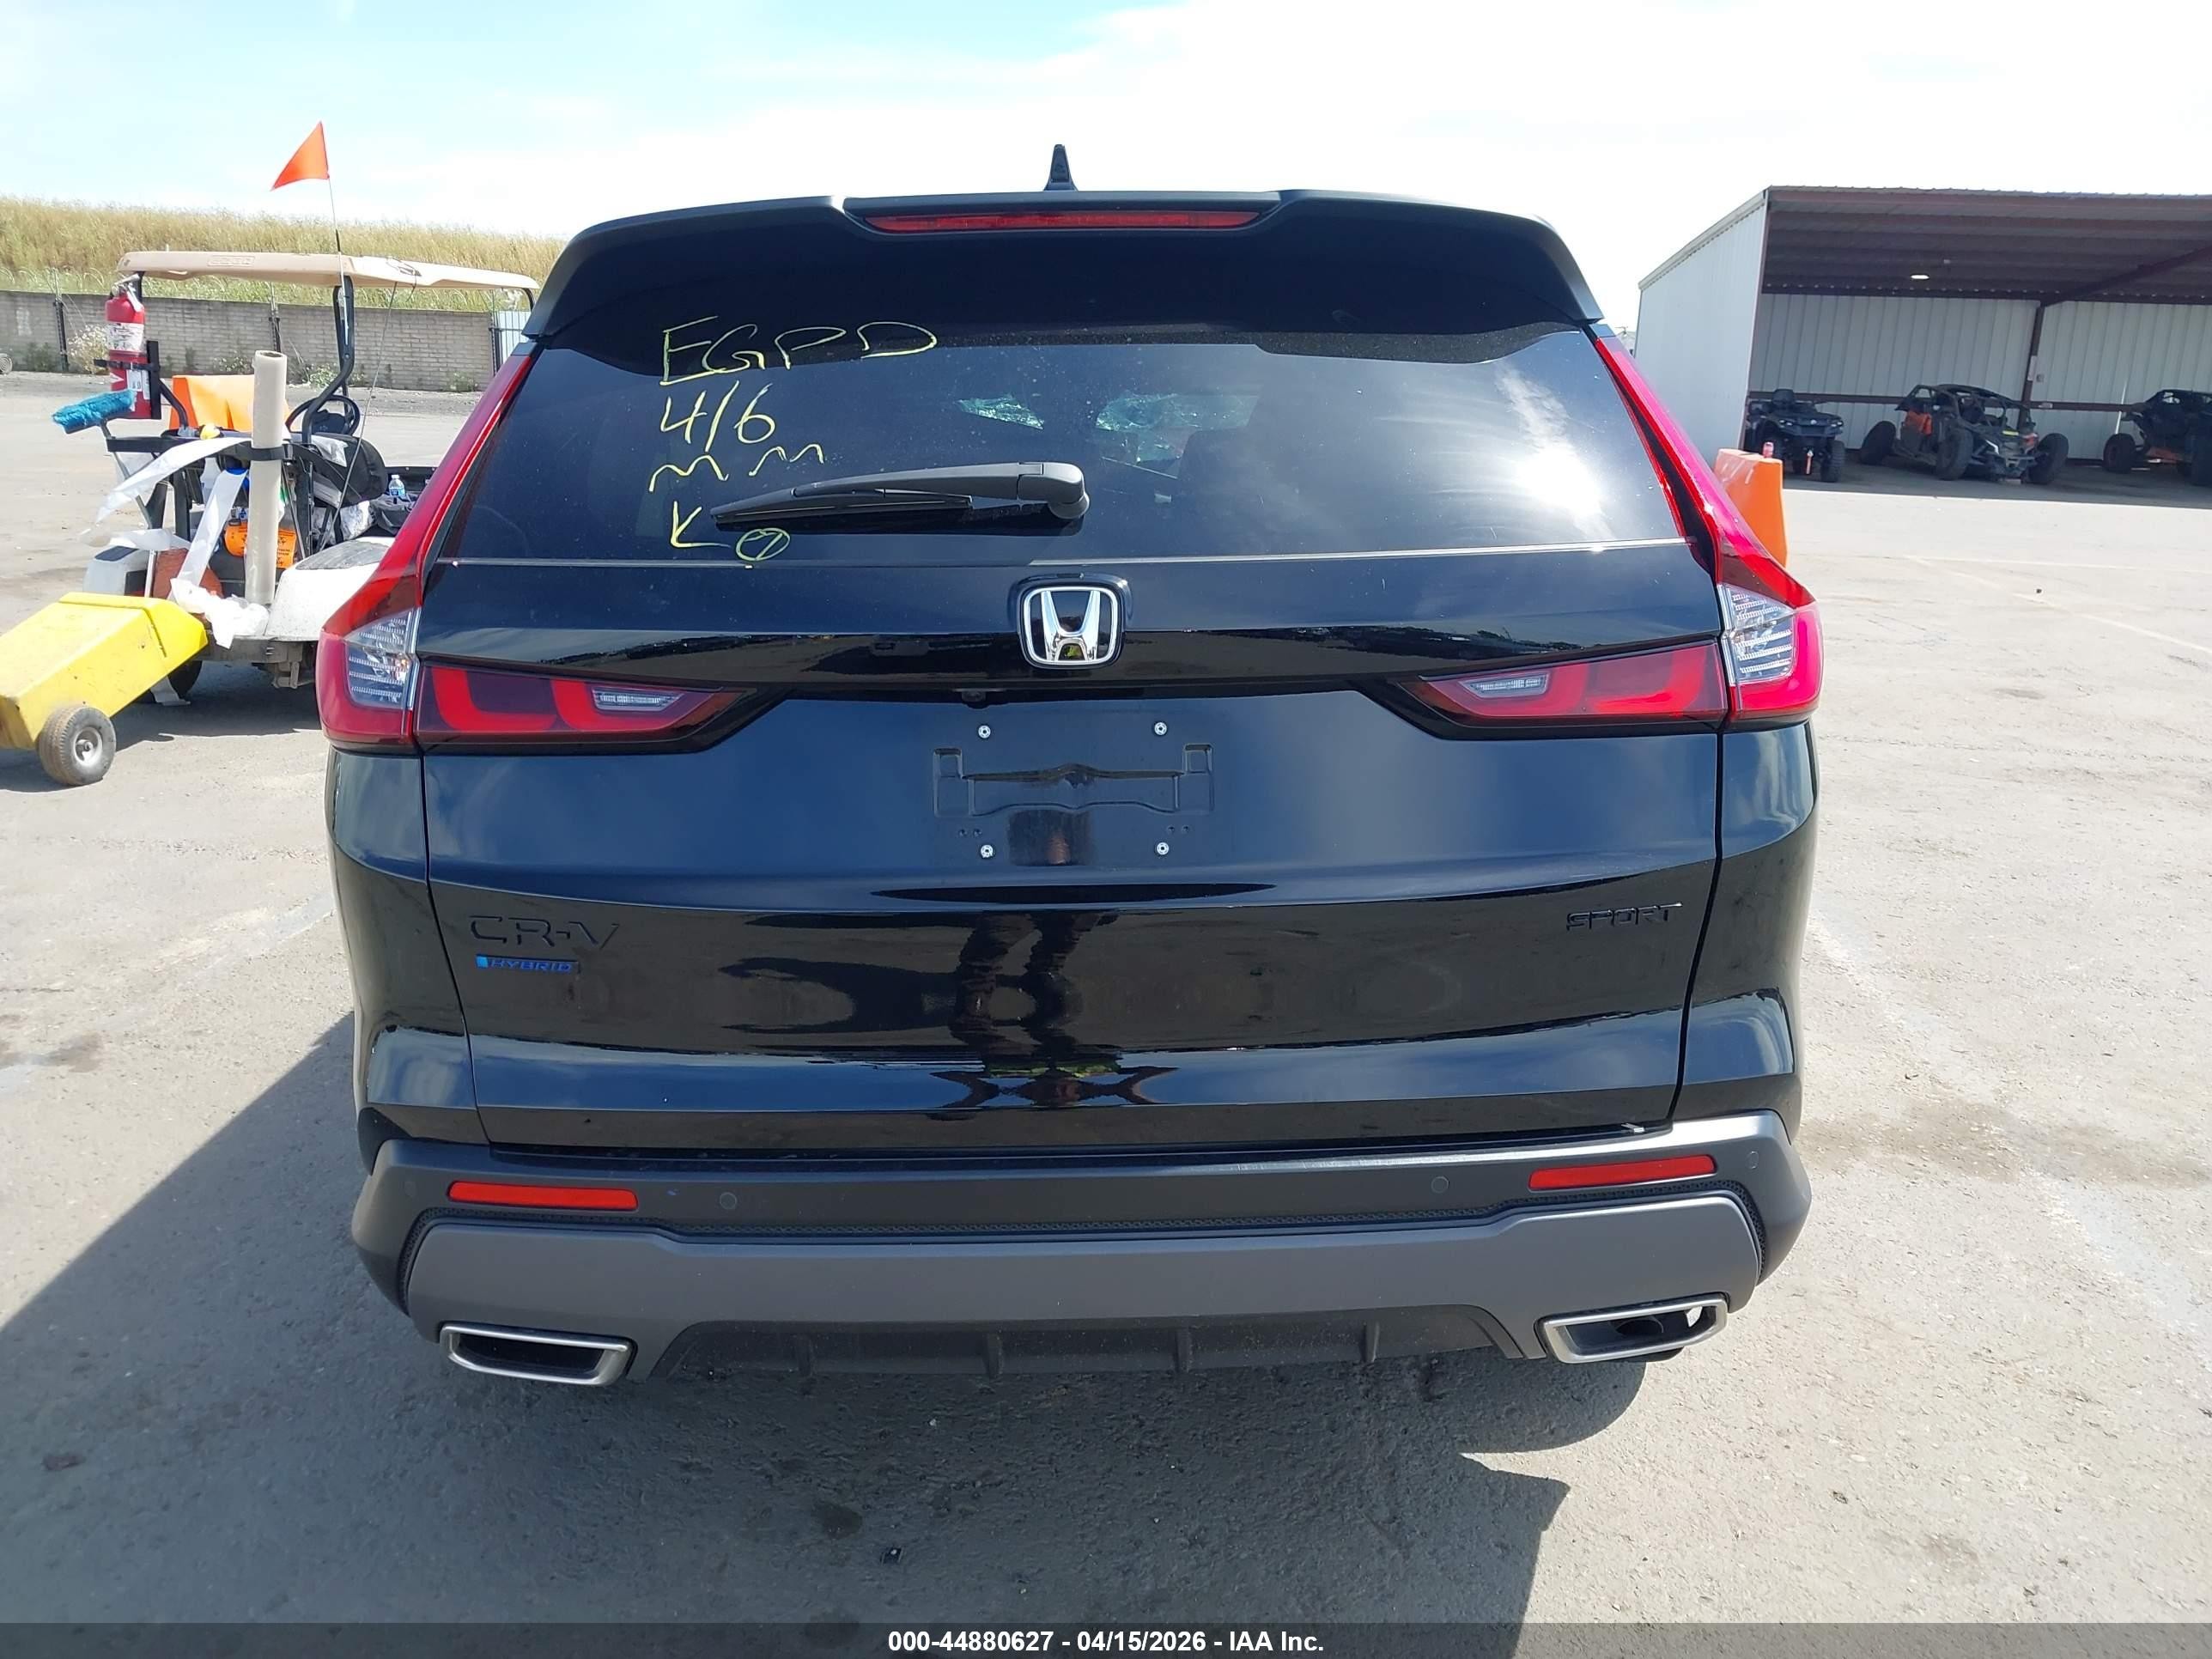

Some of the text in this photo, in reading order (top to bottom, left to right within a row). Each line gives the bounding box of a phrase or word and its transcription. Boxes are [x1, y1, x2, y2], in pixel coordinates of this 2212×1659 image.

[1565, 902, 1683, 932] SPORT
[469, 915, 620, 950] CR-V
[490, 959, 574, 973] HYBRID
